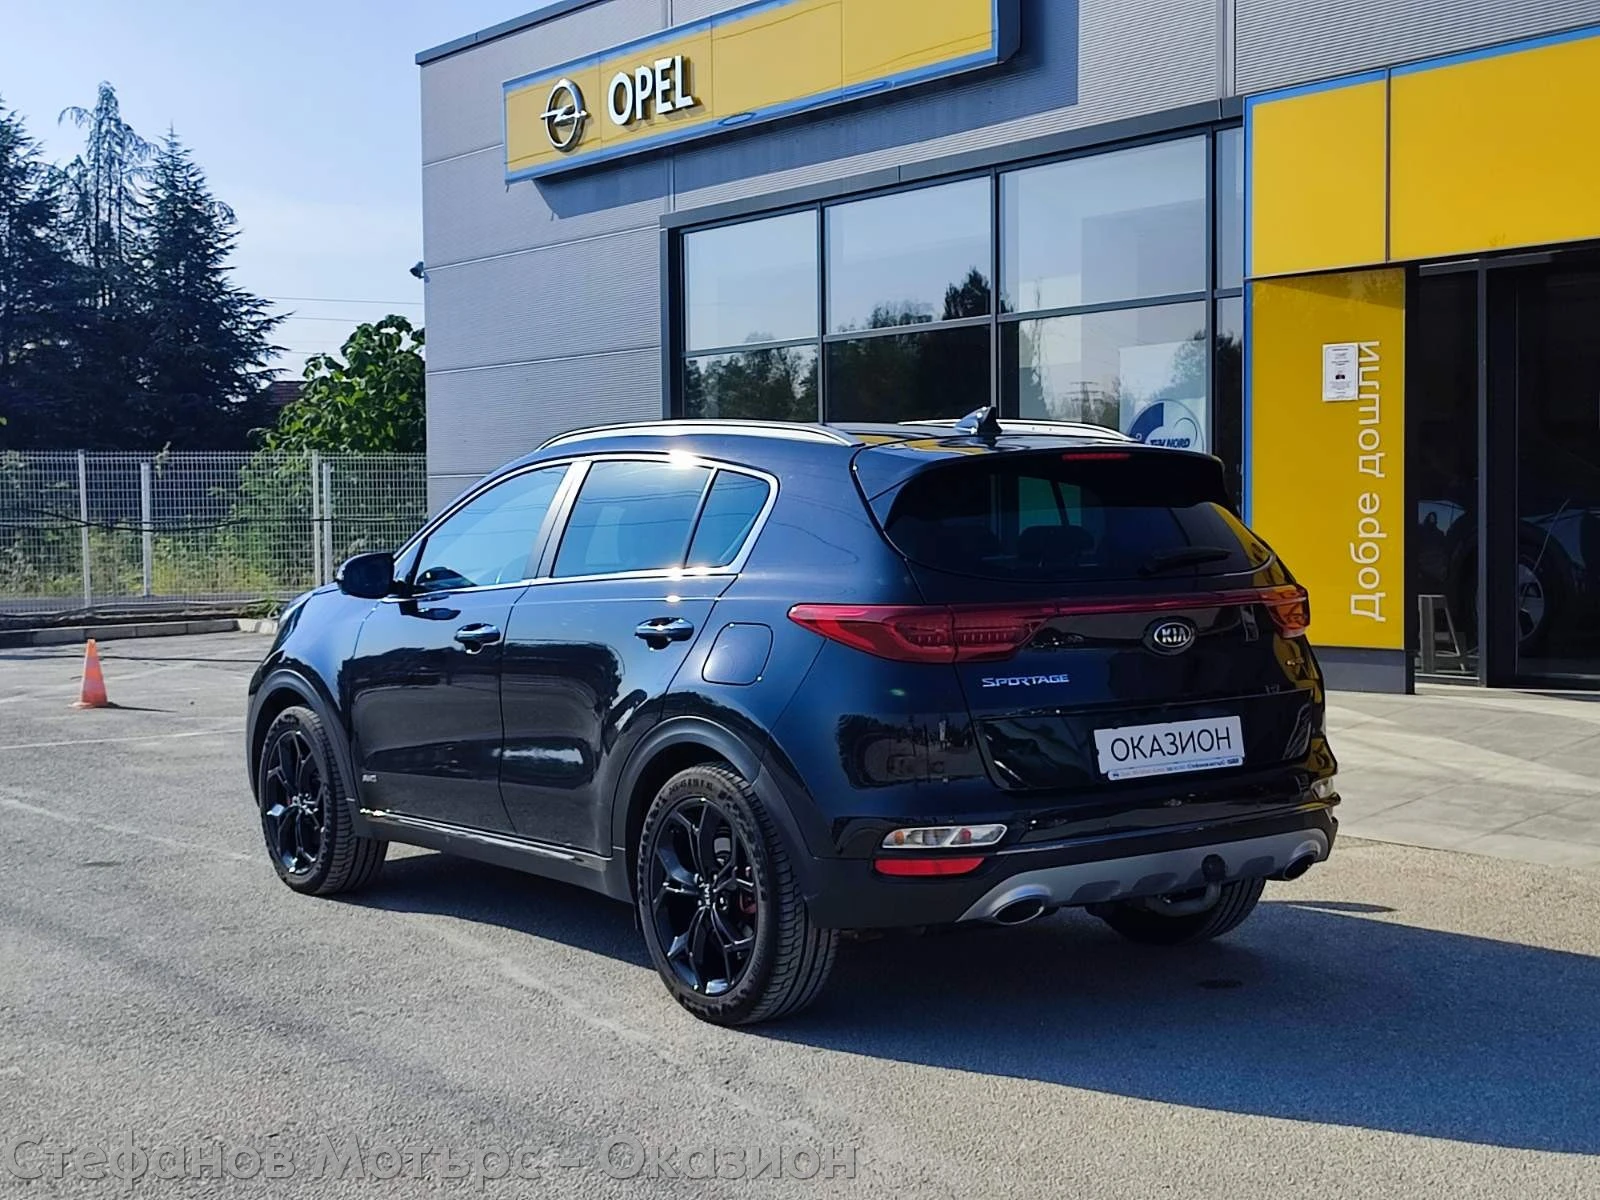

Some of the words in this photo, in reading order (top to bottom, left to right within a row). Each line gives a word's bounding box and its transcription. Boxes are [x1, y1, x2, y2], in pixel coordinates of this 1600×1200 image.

[608, 55, 694, 125] OPEL
[1358, 340, 1386, 478] дошли
[1166, 438, 1191, 448] NORD
[1350, 491, 1387, 622] Добре
[1161, 627, 1188, 644] KIA
[982, 674, 1070, 687] SPORTAGE
[1110, 726, 1231, 762] ОКАЗИОН
